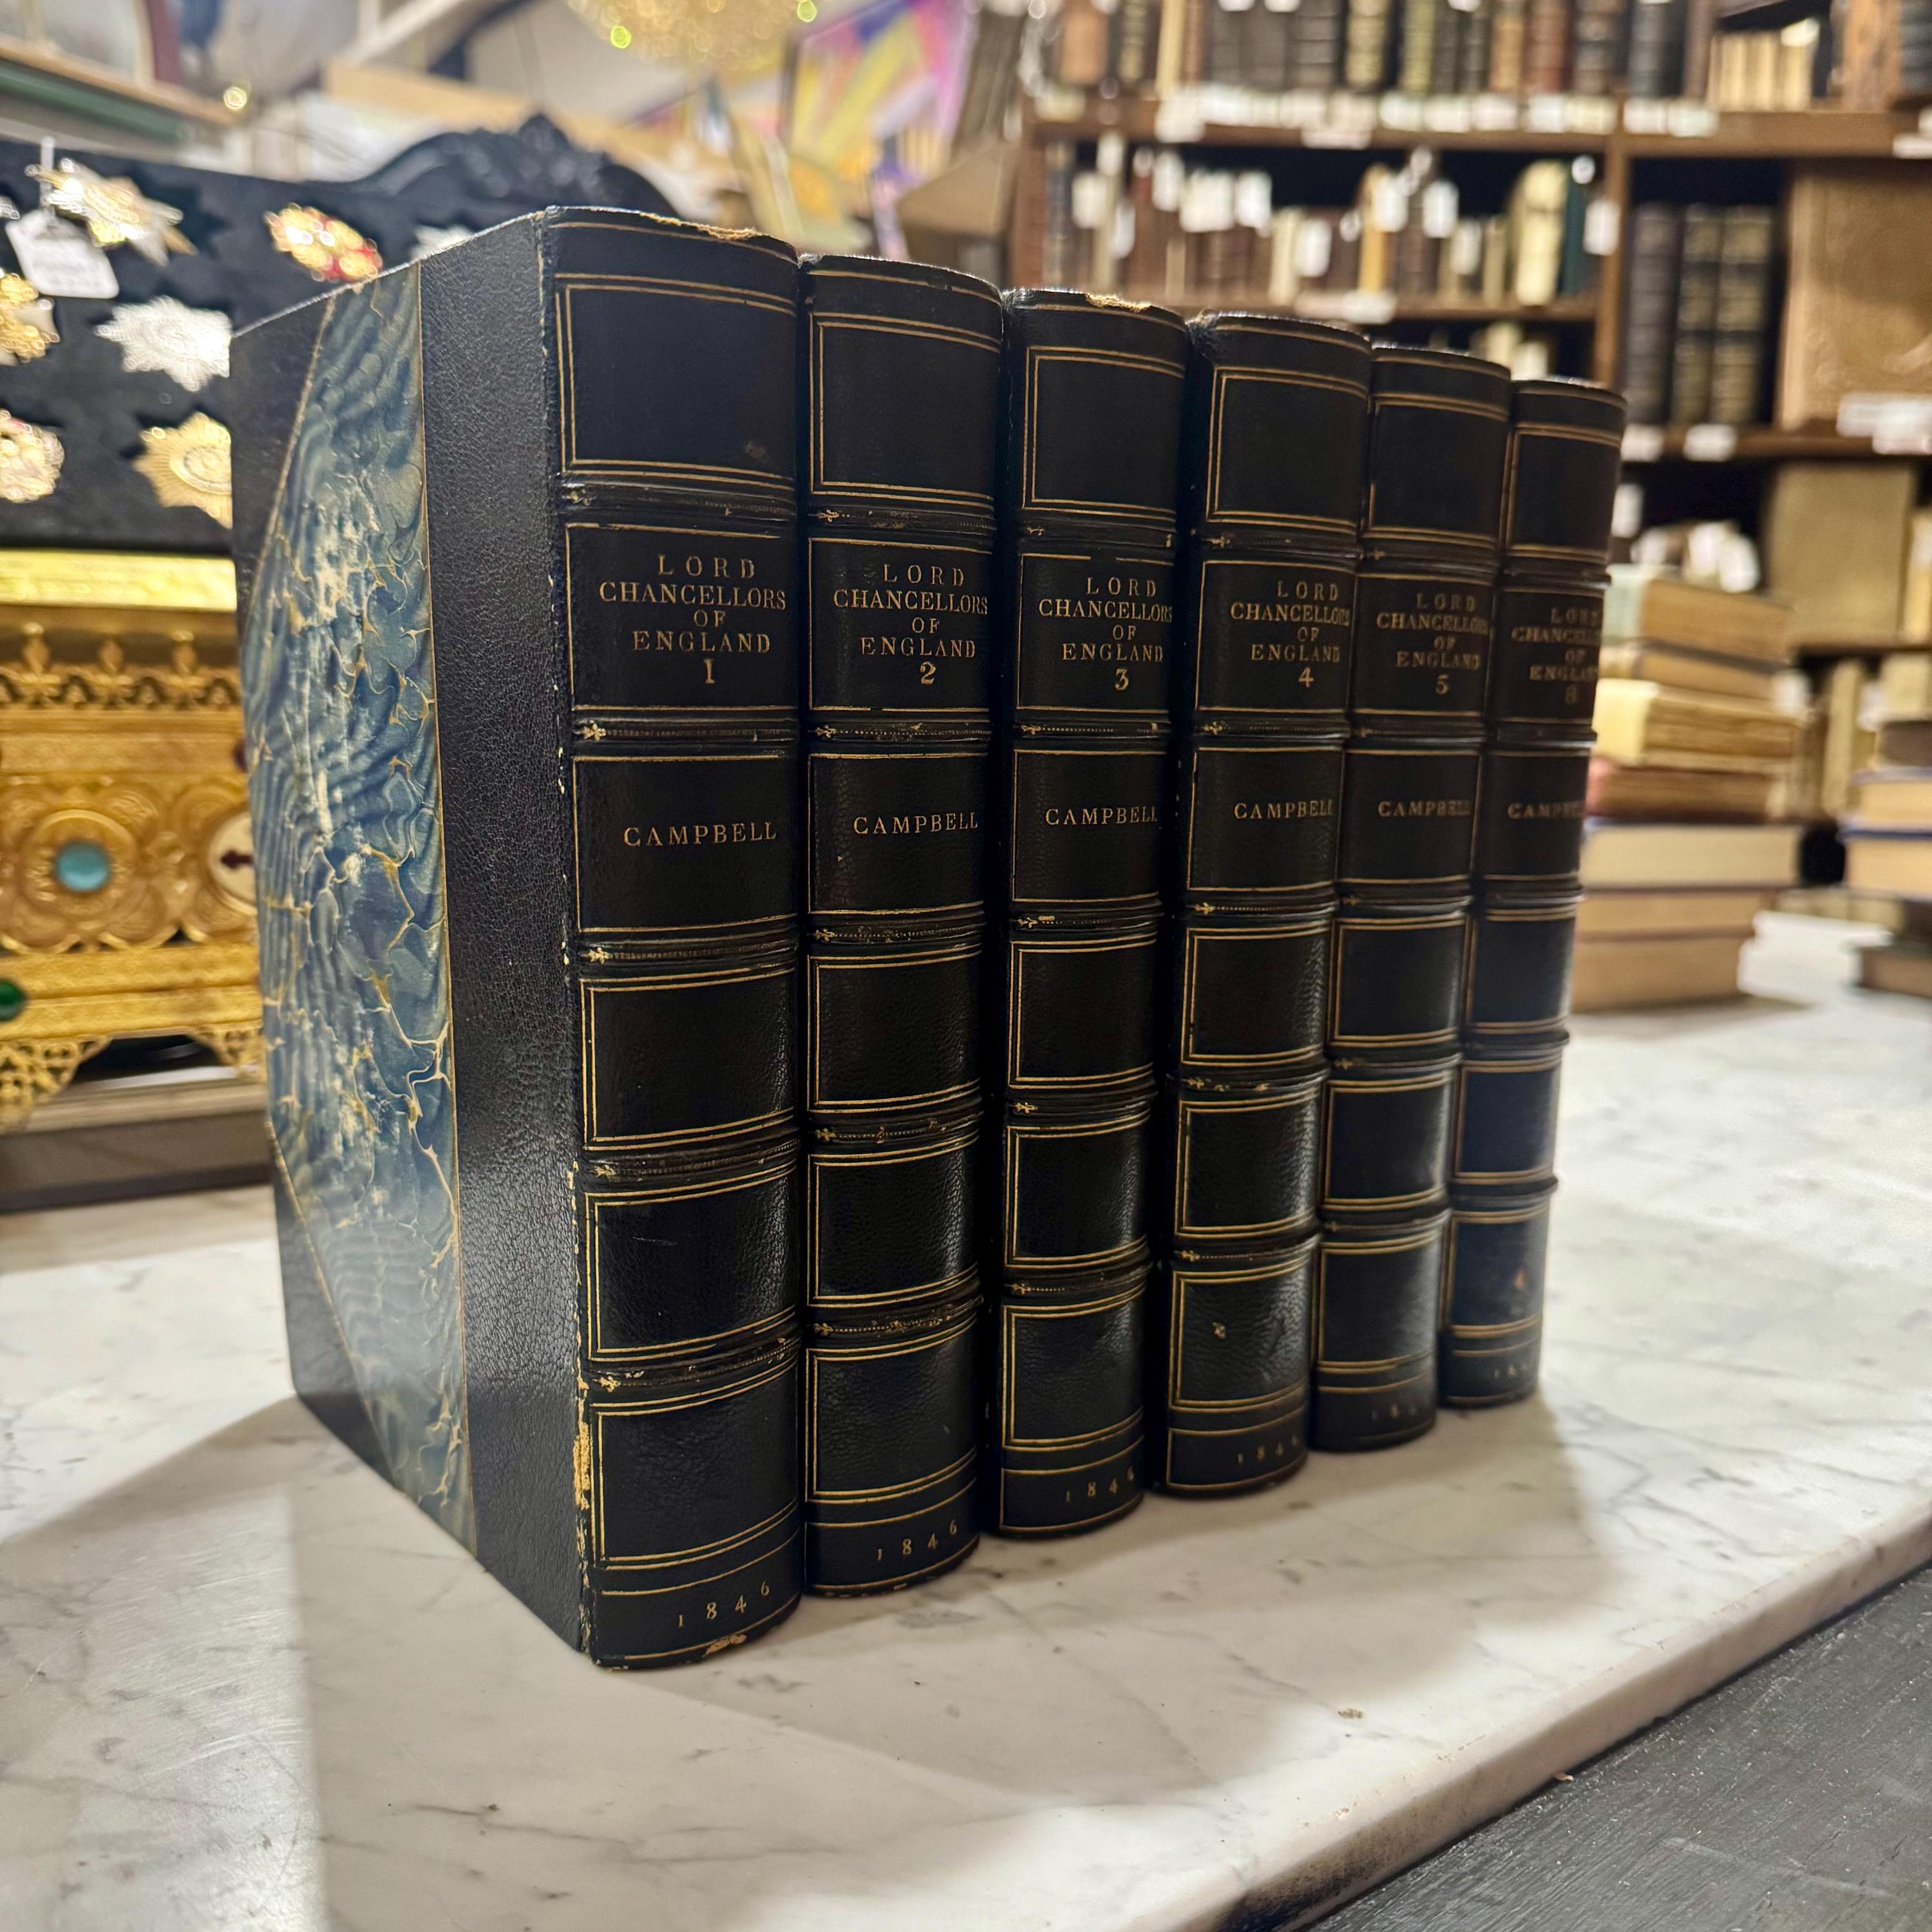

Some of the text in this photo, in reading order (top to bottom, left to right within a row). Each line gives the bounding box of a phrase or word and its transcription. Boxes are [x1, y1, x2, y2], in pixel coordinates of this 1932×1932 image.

[658, 554, 755, 579] LORD
[884, 564, 964, 586] LORD
[600, 582, 786, 609] CHANCELLORS
[1086, 576, 1157, 598] LORD
[1277, 581, 1339, 601] LORD
[833, 589, 988, 615] CHANCELLORS
[1038, 598, 1172, 623] CHANCELLORS
[693, 610, 726, 627] OF
[911, 616, 940, 634] OF
[632, 630, 770, 654] ENGLAND
[1112, 625, 1137, 640] OF
[1297, 627, 1319, 642] OF
[860, 636, 976, 658] ENGLAND
[1062, 643, 1163, 663] ENGLAND
[1251, 644, 1341, 663] ENGLAND
[703, 658, 715, 684] 1
[920, 661, 937, 685] 2
[1114, 668, 1130, 690] 3
[1298, 667, 1314, 688] 4
[1435, 674, 1450, 696] 5
[1045, 805, 1157, 826] CAMPBELL
[1233, 799, 1334, 820] CAMPBELL
[853, 810, 978, 836] CAMPBELL
[623, 822, 777, 848] CAMPBELL
[876, 1519, 958, 1562] 1846
[677, 1580, 770, 1628] 1846
